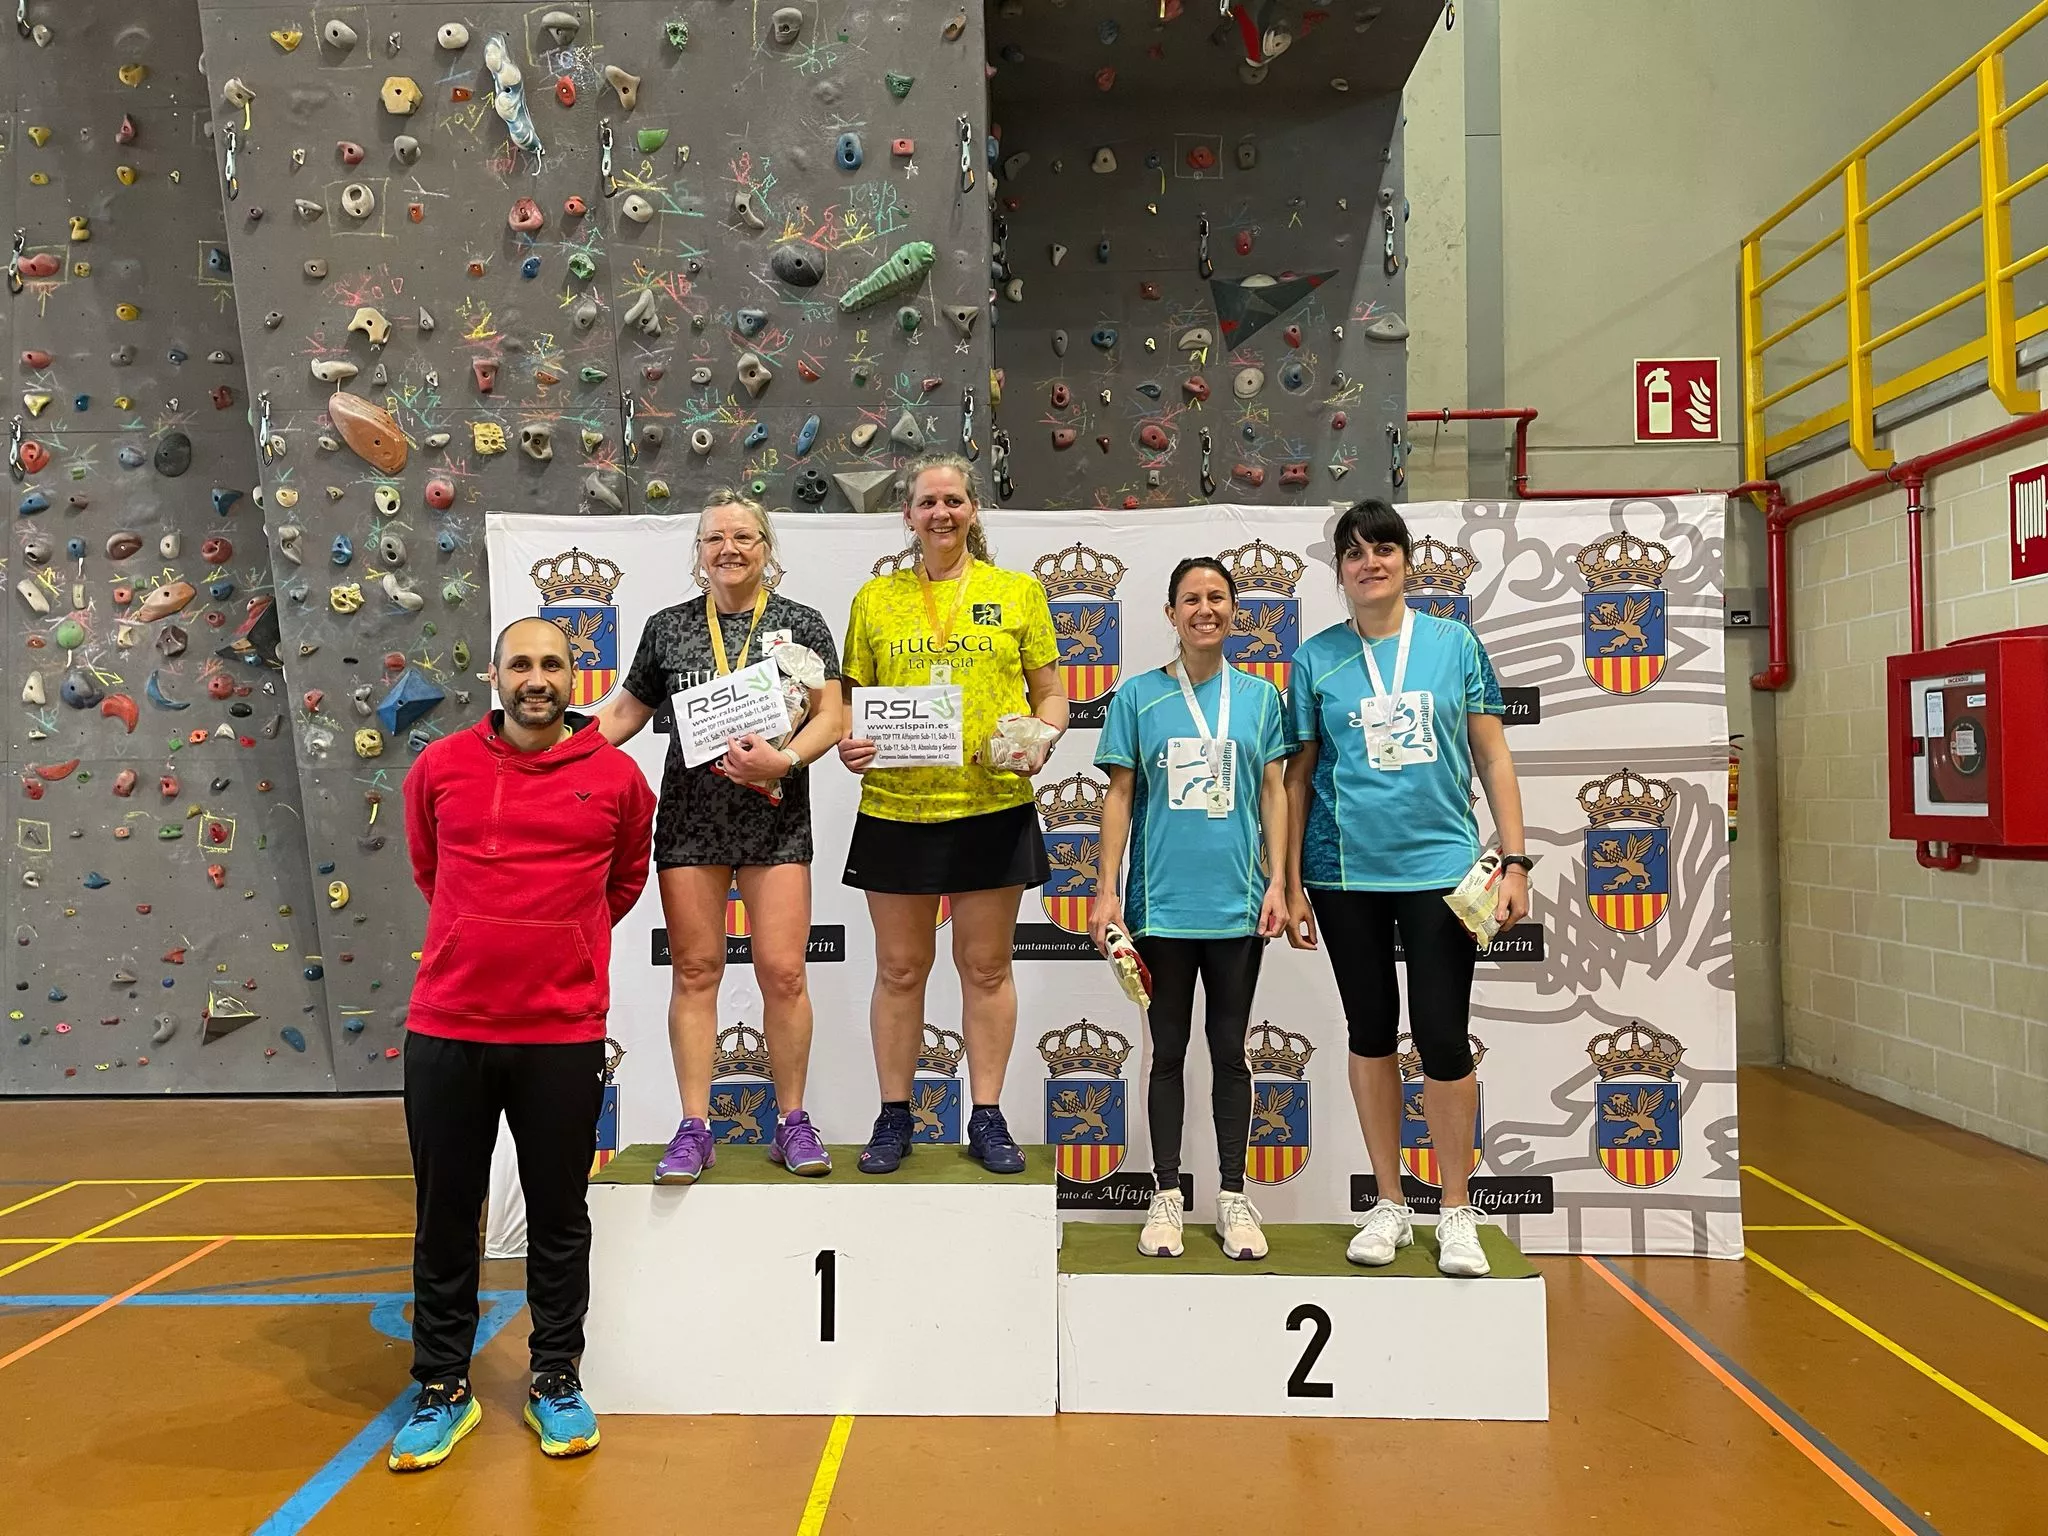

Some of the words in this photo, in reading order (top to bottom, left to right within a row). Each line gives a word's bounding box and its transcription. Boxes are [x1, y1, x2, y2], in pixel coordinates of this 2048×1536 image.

[687, 684, 749, 719] RSL
[692, 694, 769, 727] www.rslspain.es
[865, 700, 929, 719] RSL
[867, 722, 949, 731] www.rslspain.es
[1012, 942, 1076, 952] yuntamiento
[1078, 941, 1090, 951] de
[1081, 1190, 1093, 1200] de
[1472, 1188, 1543, 1210] lfajarín
[815, 1250, 835, 1341] 1
[1286, 1303, 1334, 1398] 2
